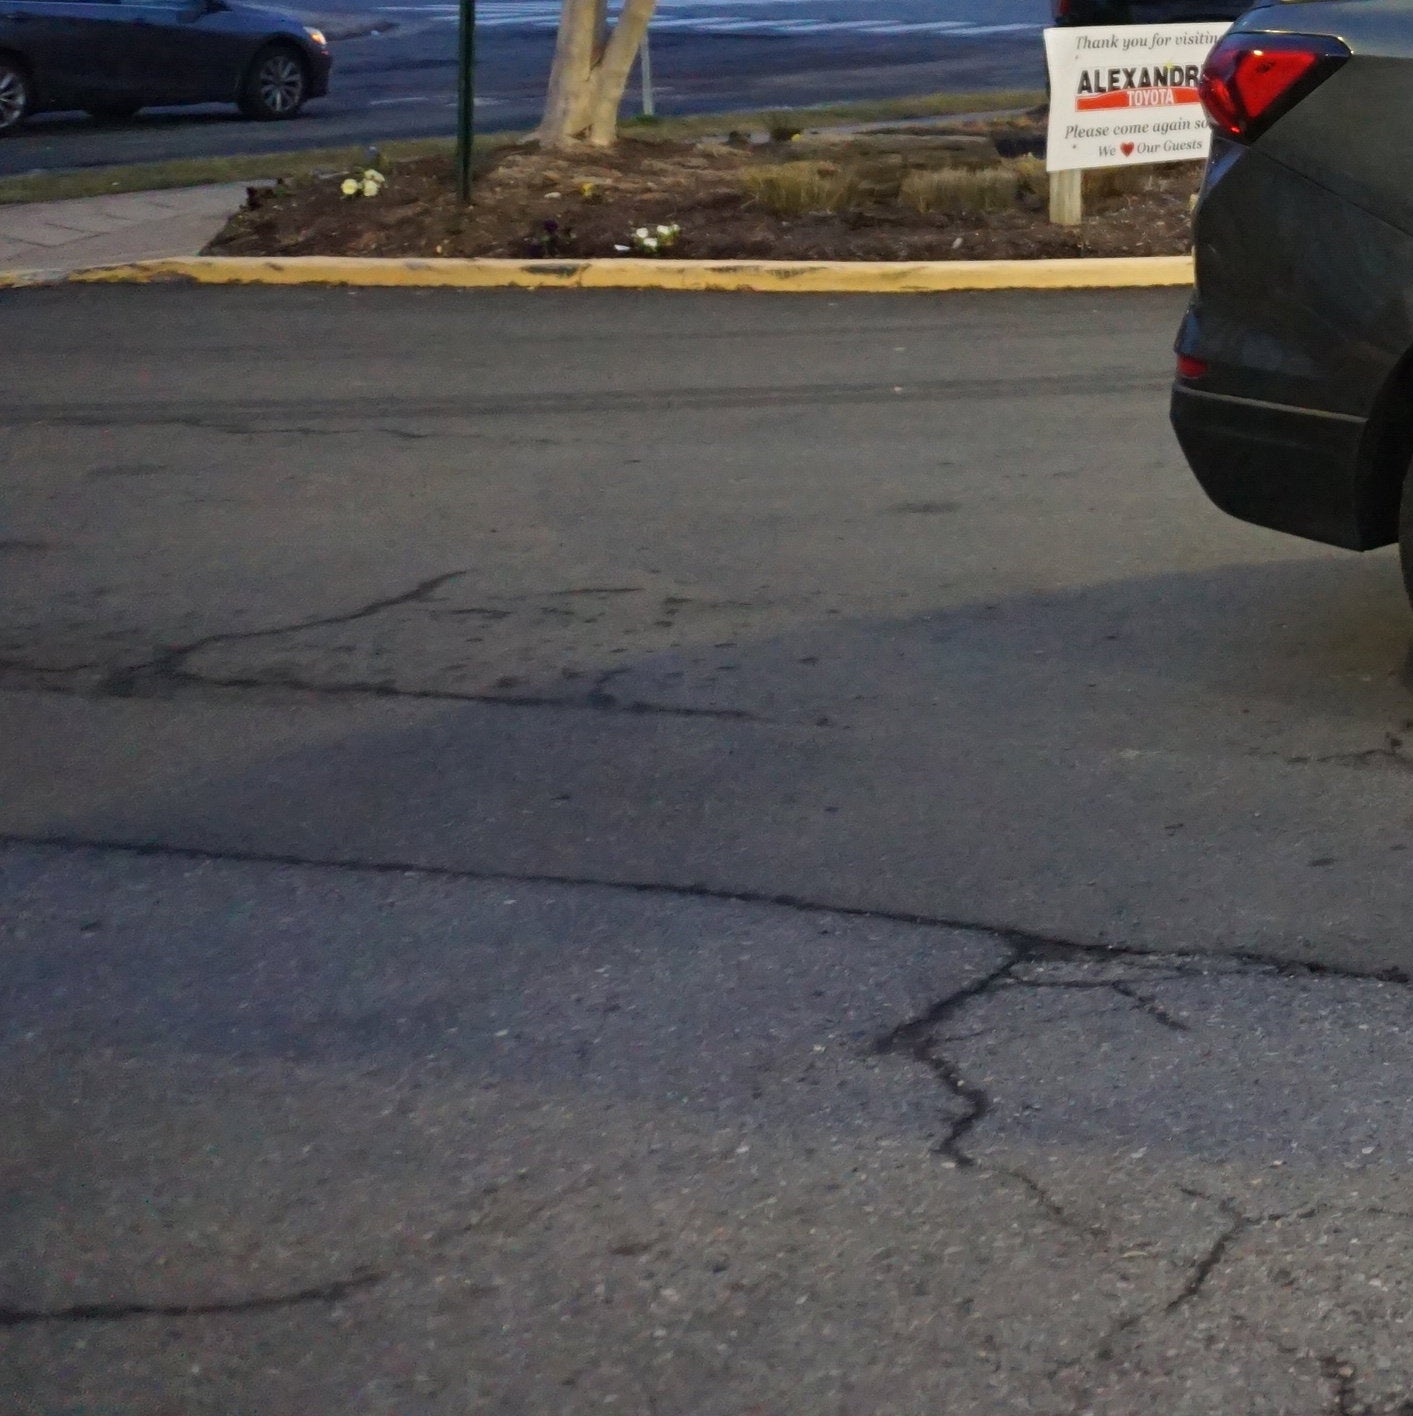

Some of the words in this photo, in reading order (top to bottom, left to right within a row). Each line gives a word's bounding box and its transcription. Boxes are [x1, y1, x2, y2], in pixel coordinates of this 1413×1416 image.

[1076, 34, 1119, 50] Thank
[1122, 36, 1148, 51] you
[1148, 32, 1172, 50] for
[1175, 30, 1218, 46] visitin
[1077, 64, 1201, 94] ALEXANDR
[1127, 87, 1175, 107] TOYOTA
[1065, 125, 1110, 139] Please
[1113, 123, 1149, 135] come
[1152, 117, 1191, 135] again
[1194, 119, 1208, 130] so
[1099, 145, 1116, 158] We
[1137, 141, 1161, 154] Our
[1164, 139, 1203, 152] Guests
